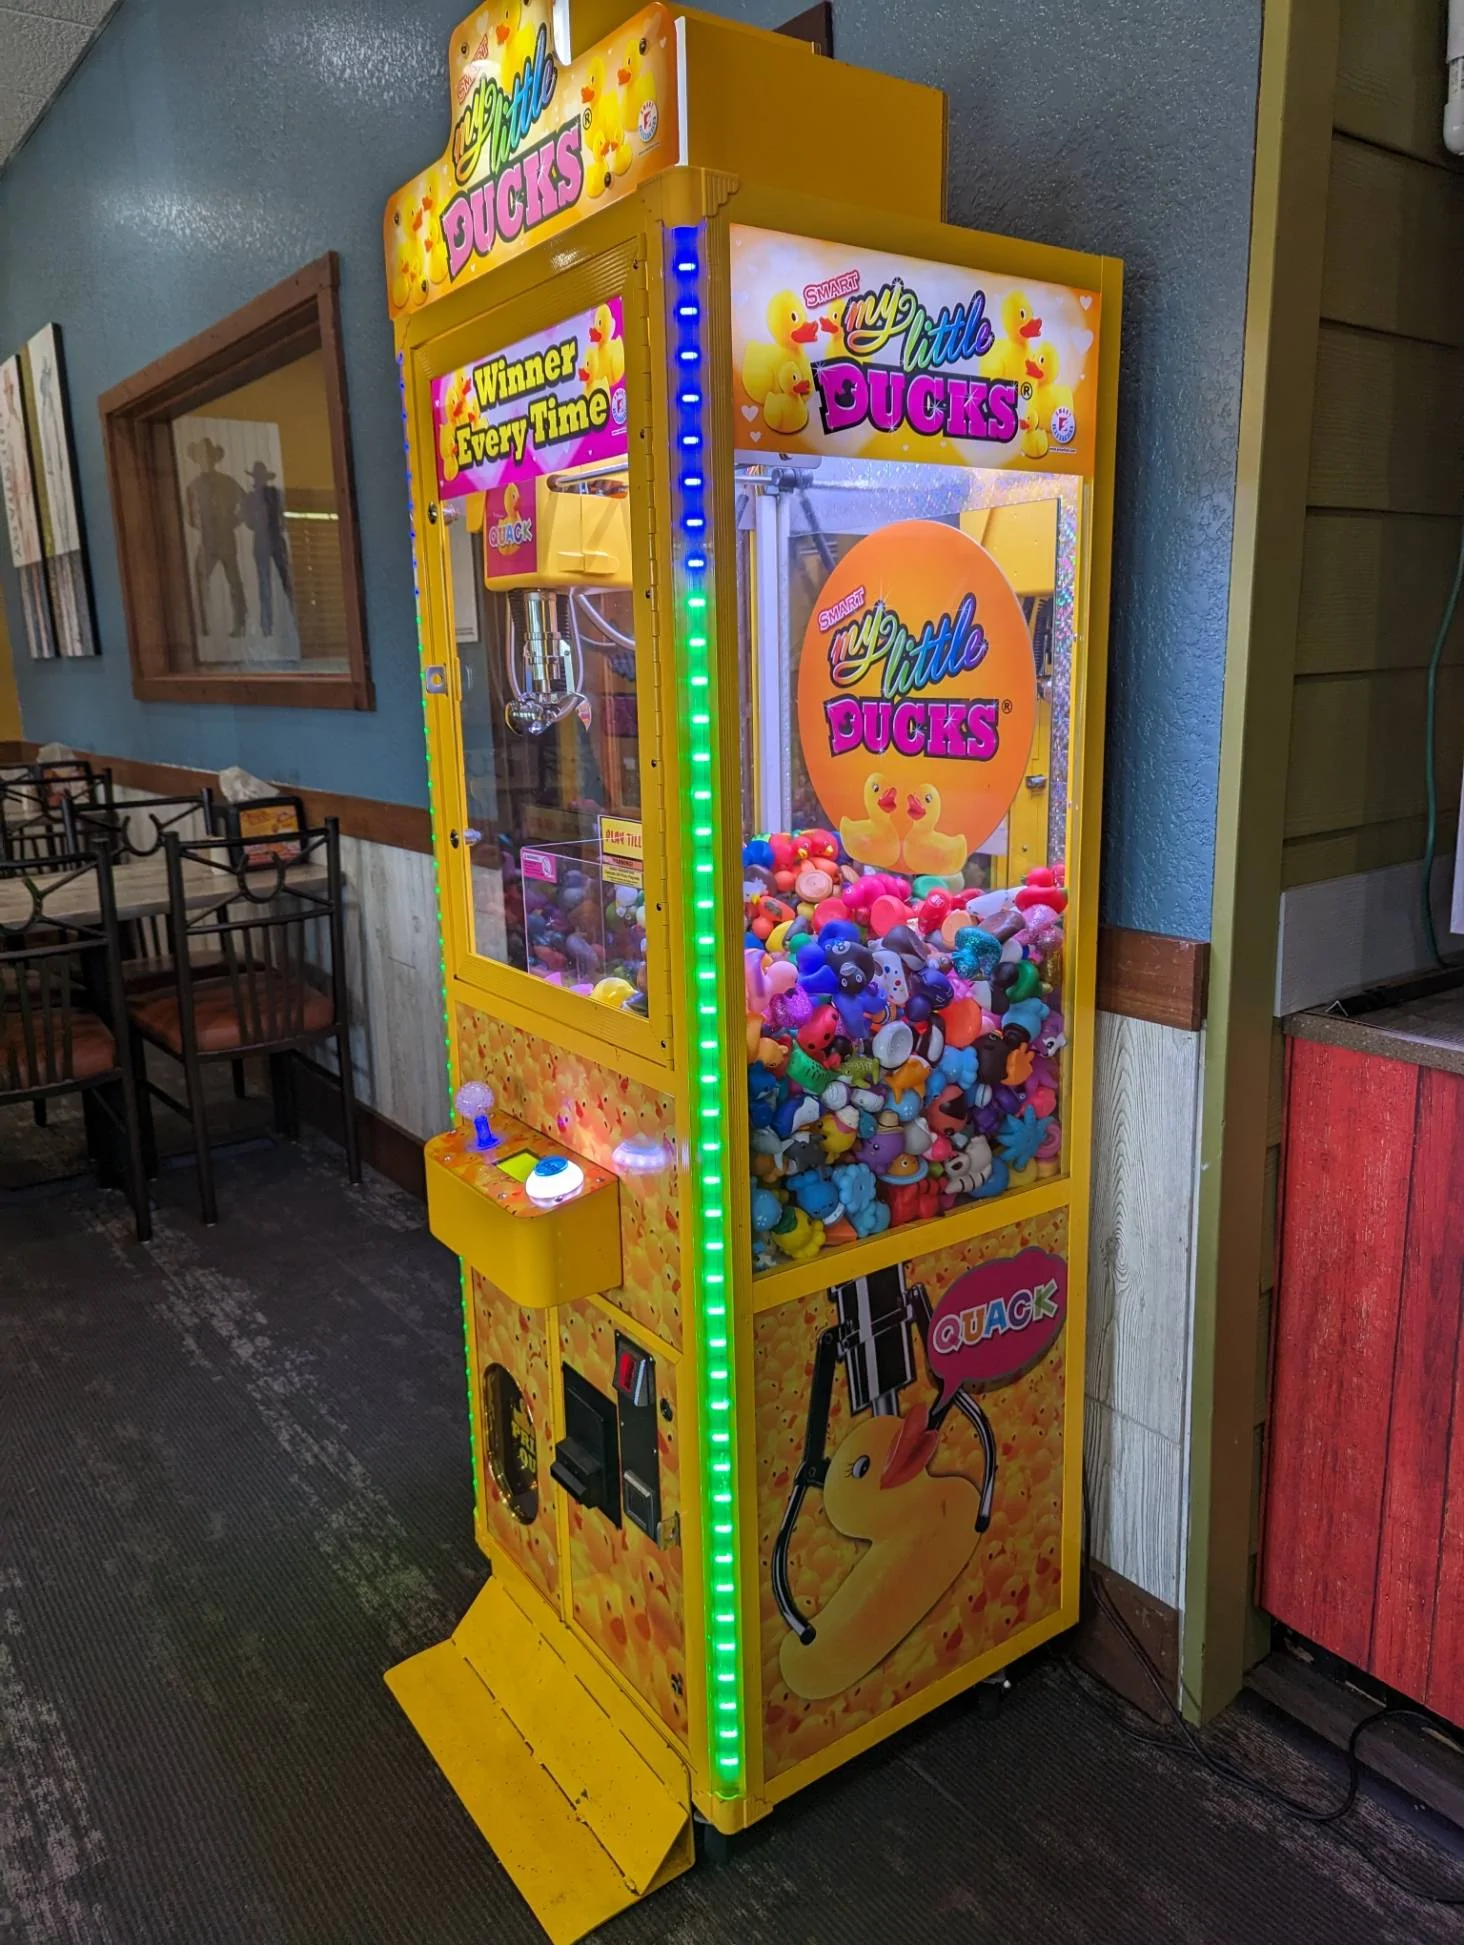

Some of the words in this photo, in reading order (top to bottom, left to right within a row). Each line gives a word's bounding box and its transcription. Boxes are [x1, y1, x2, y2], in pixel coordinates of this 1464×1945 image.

[452, 73, 504, 186] my
[489, 22, 558, 175] little
[440, 114, 584, 283] DUCKS
[803, 269, 860, 309] SMART
[843, 277, 918, 357] my
[901, 290, 995, 373] little
[473, 336, 578, 411] Winner
[811, 357, 1018, 443] DUCKS
[455, 415, 528, 469] Every
[529, 390, 610, 448] Time
[489, 517, 533, 548] QUACK
[818, 586, 865, 633] SMART
[828, 600, 900, 688] my
[882, 592, 989, 700] little
[824, 694, 999, 761] DUCKS
[933, 1279, 1058, 1354] QUACK
